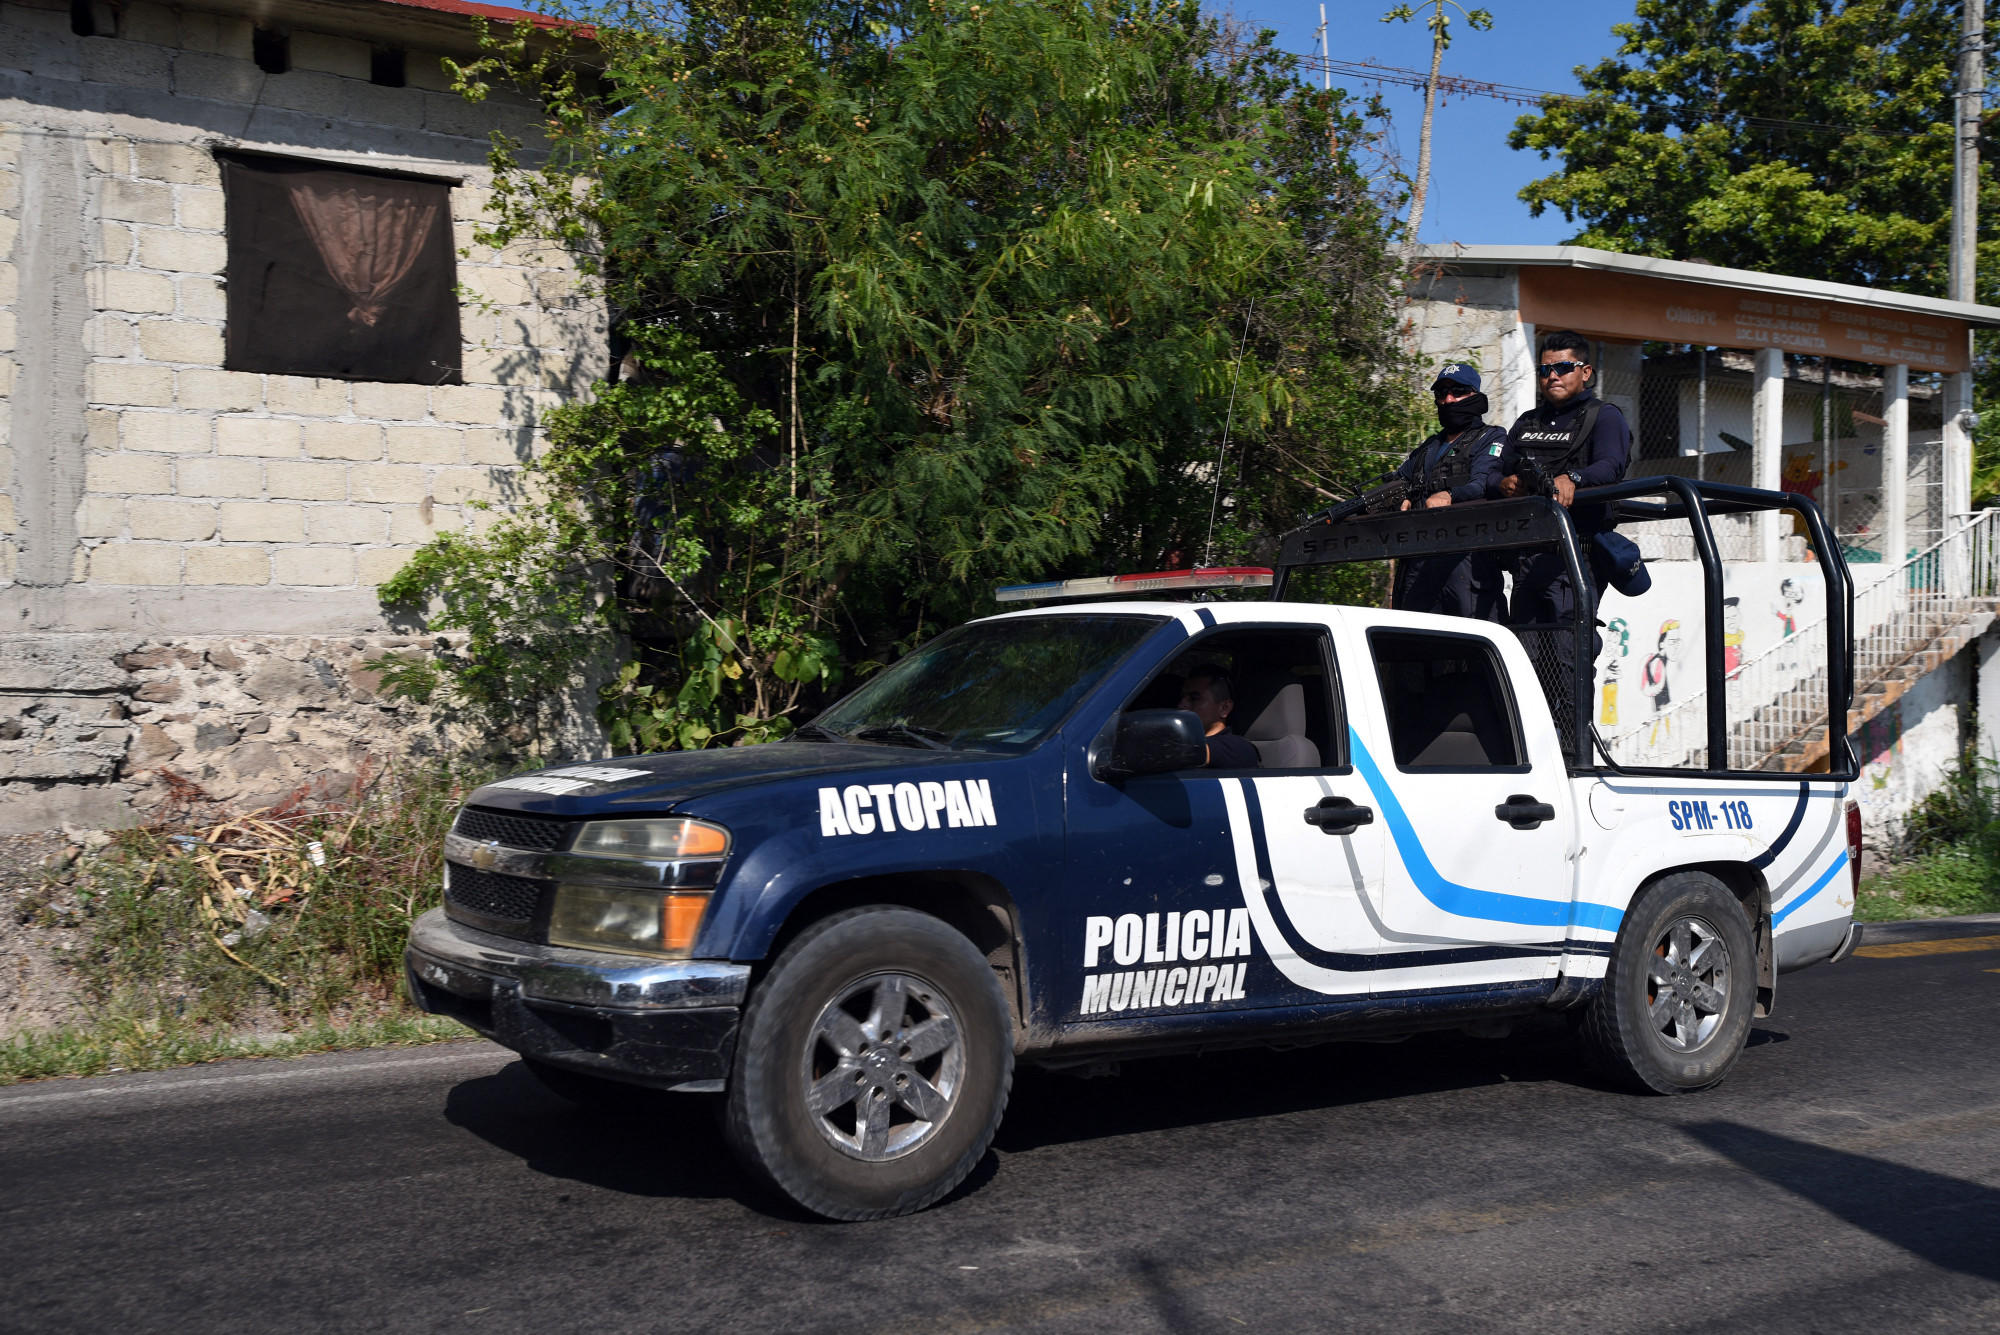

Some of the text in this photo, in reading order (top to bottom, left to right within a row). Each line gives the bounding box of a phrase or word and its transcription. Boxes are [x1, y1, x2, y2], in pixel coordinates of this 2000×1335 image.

[1521, 432, 1571, 441] POLICIA
[818, 778, 997, 837] ACTOPAN
[1084, 907, 1252, 968] POLICIA
[1080, 962, 1248, 1015] MUNICIPAL
